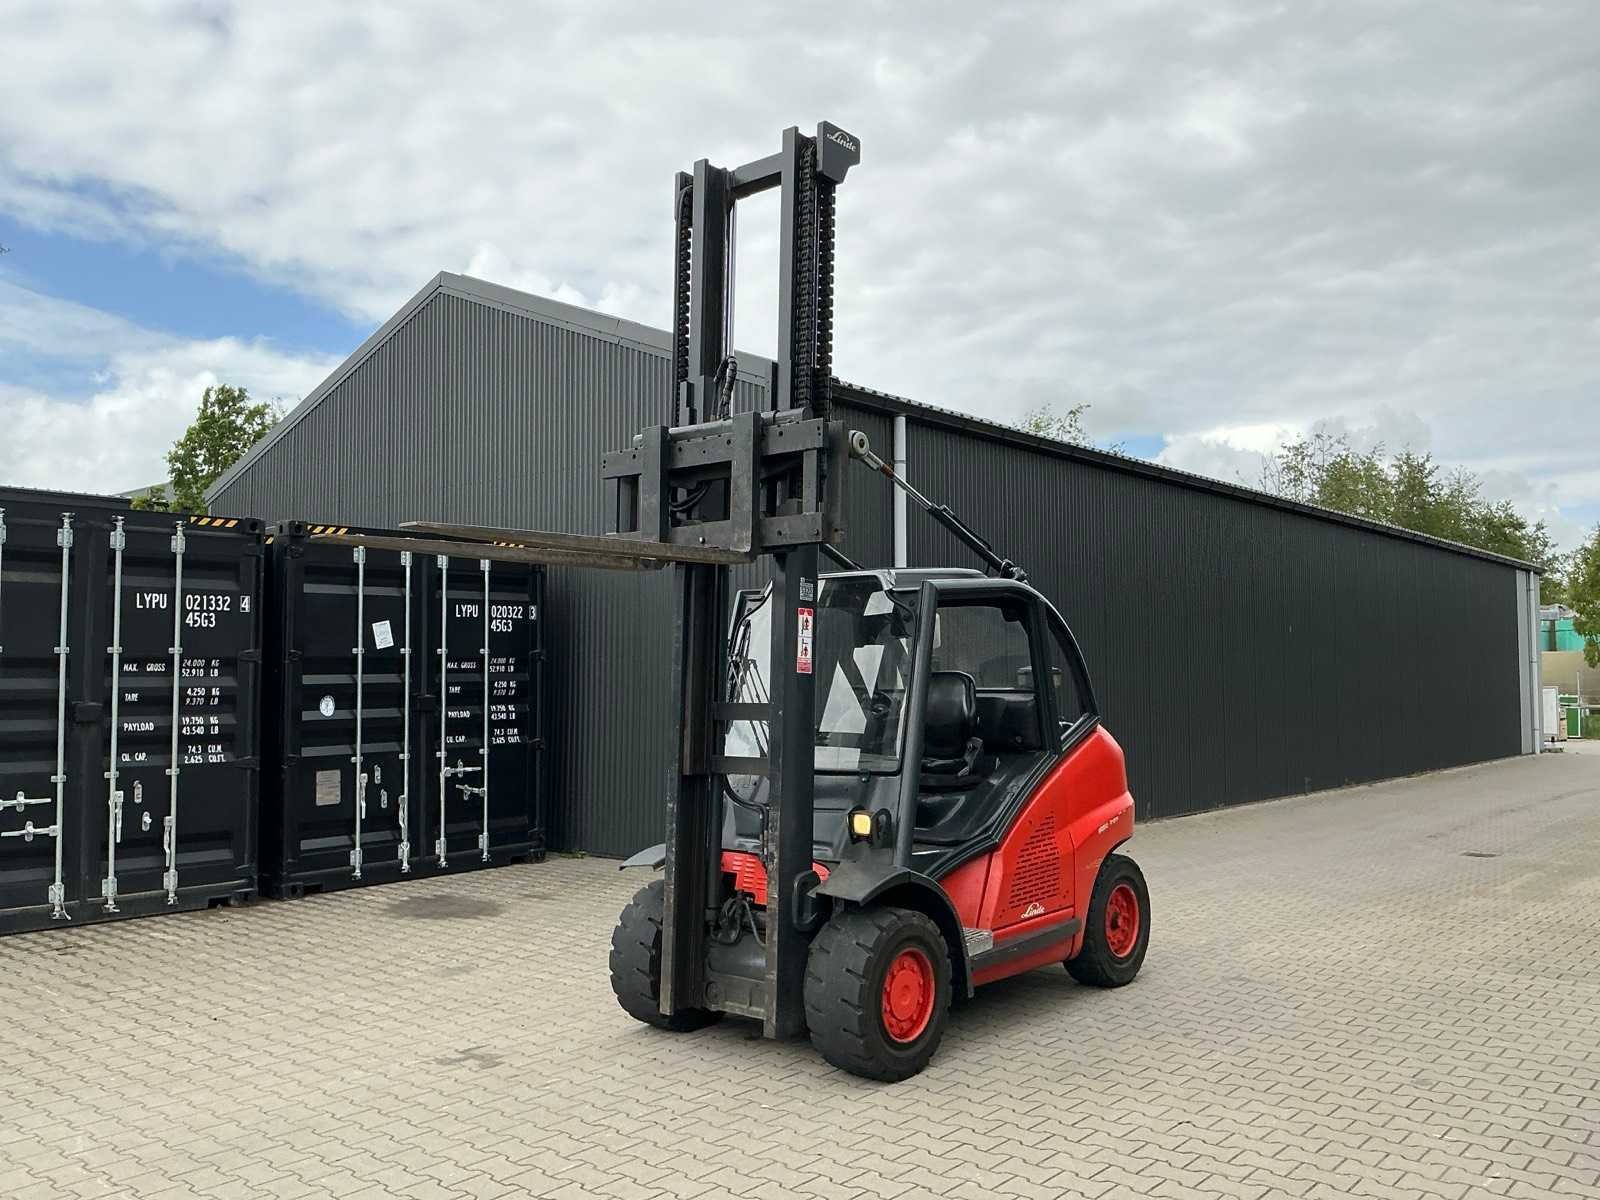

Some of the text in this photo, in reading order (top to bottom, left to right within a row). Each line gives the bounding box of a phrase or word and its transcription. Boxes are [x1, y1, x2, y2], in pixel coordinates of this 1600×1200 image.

[826, 131, 857, 152] Linde
[136, 593, 251, 612] LYPU 021332 4
[455, 604, 537, 620] LYPU 020322 3
[185, 612, 216, 628] 45G3
[490, 619, 513, 632] 45G3
[146, 663, 166, 672] GROSS
[211, 659, 220, 667] KG
[460, 661, 477, 669] GROSS
[181, 668, 219, 677] 52.910 LB
[186, 687, 220, 696] 4.250 KG
[448, 686, 462, 694] TARE
[124, 693, 140, 702] TARE
[209, 697, 219, 706] LB
[447, 710, 471, 719] PAYLOAD
[210, 716, 219, 725] KG
[123, 722, 155, 732] PAYLOAD
[210, 725, 220, 735] LB
[1020, 902, 1046, 919] Linde
